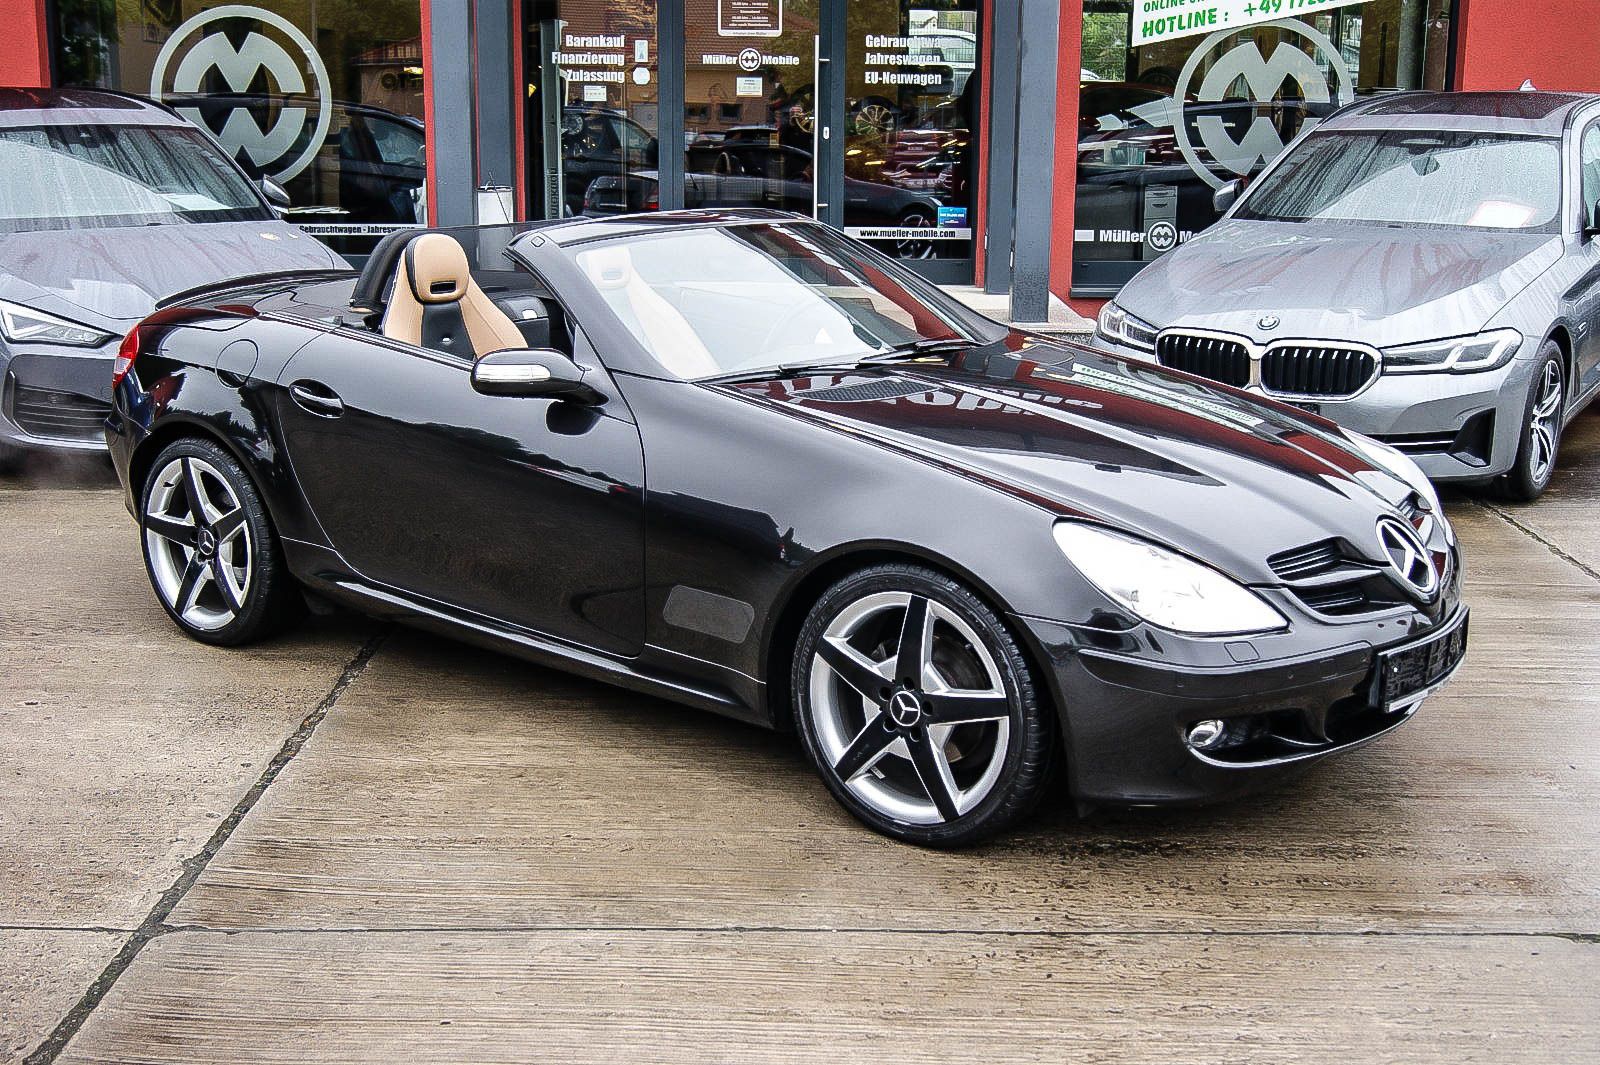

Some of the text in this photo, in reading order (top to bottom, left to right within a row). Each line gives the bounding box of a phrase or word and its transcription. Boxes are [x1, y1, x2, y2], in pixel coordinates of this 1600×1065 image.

[1142, 8, 1217, 37] HOTLINE
[565, 34, 626, 48] Barankauf
[551, 51, 625, 66] Finanzierung
[702, 54, 800, 66] Müller Mobile
[864, 52, 941, 66] Jahreswagen
[566, 69, 625, 83] Zulassung
[864, 71, 942, 86] EU-Neuwagen
[859, 229, 956, 238] www.mueller-mobile.com
[1099, 229, 1147, 243] Müller
